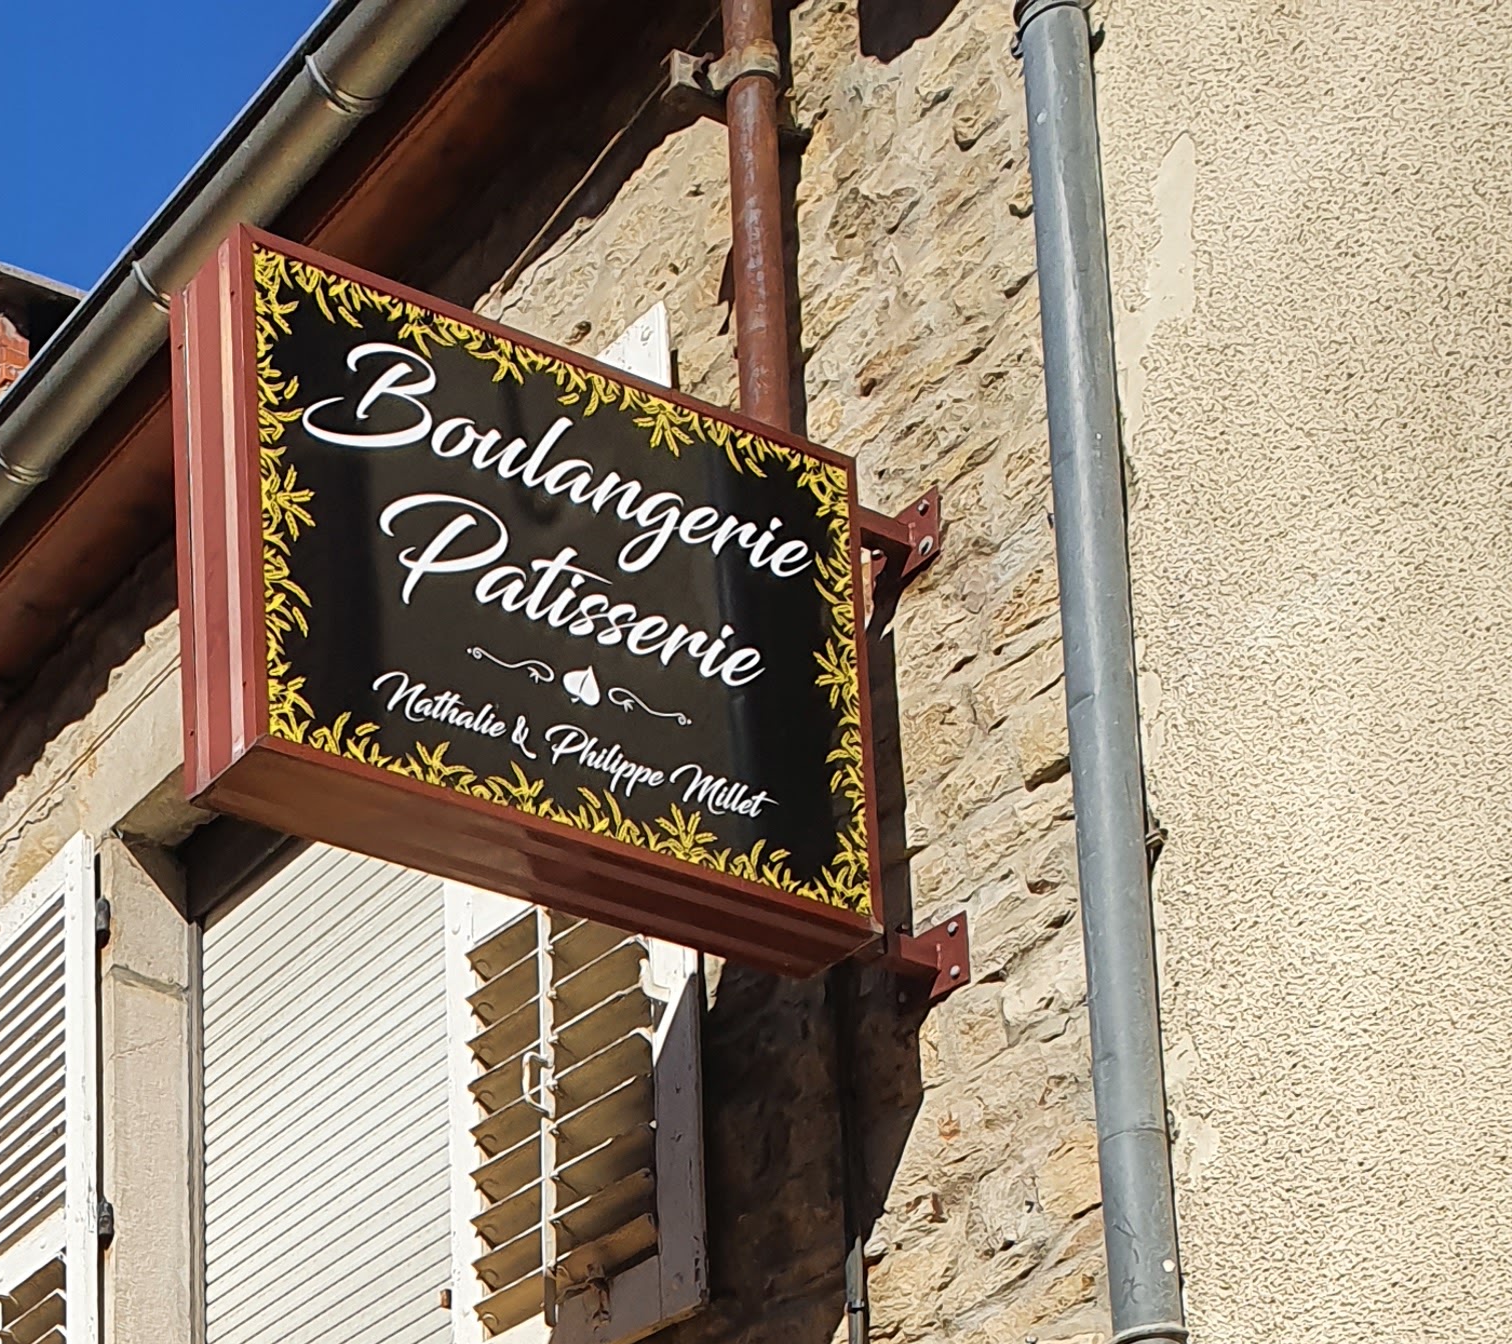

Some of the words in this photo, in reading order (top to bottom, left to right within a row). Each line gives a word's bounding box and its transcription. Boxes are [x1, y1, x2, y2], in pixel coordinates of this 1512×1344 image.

[302, 342, 812, 580] Boulangerie
[379, 493, 765, 687] Patisserie
[372, 671, 506, 738] Nathalie
[511, 715, 537, 759] &
[544, 724, 665, 797] Philippe
[669, 764, 779, 818] Millet
